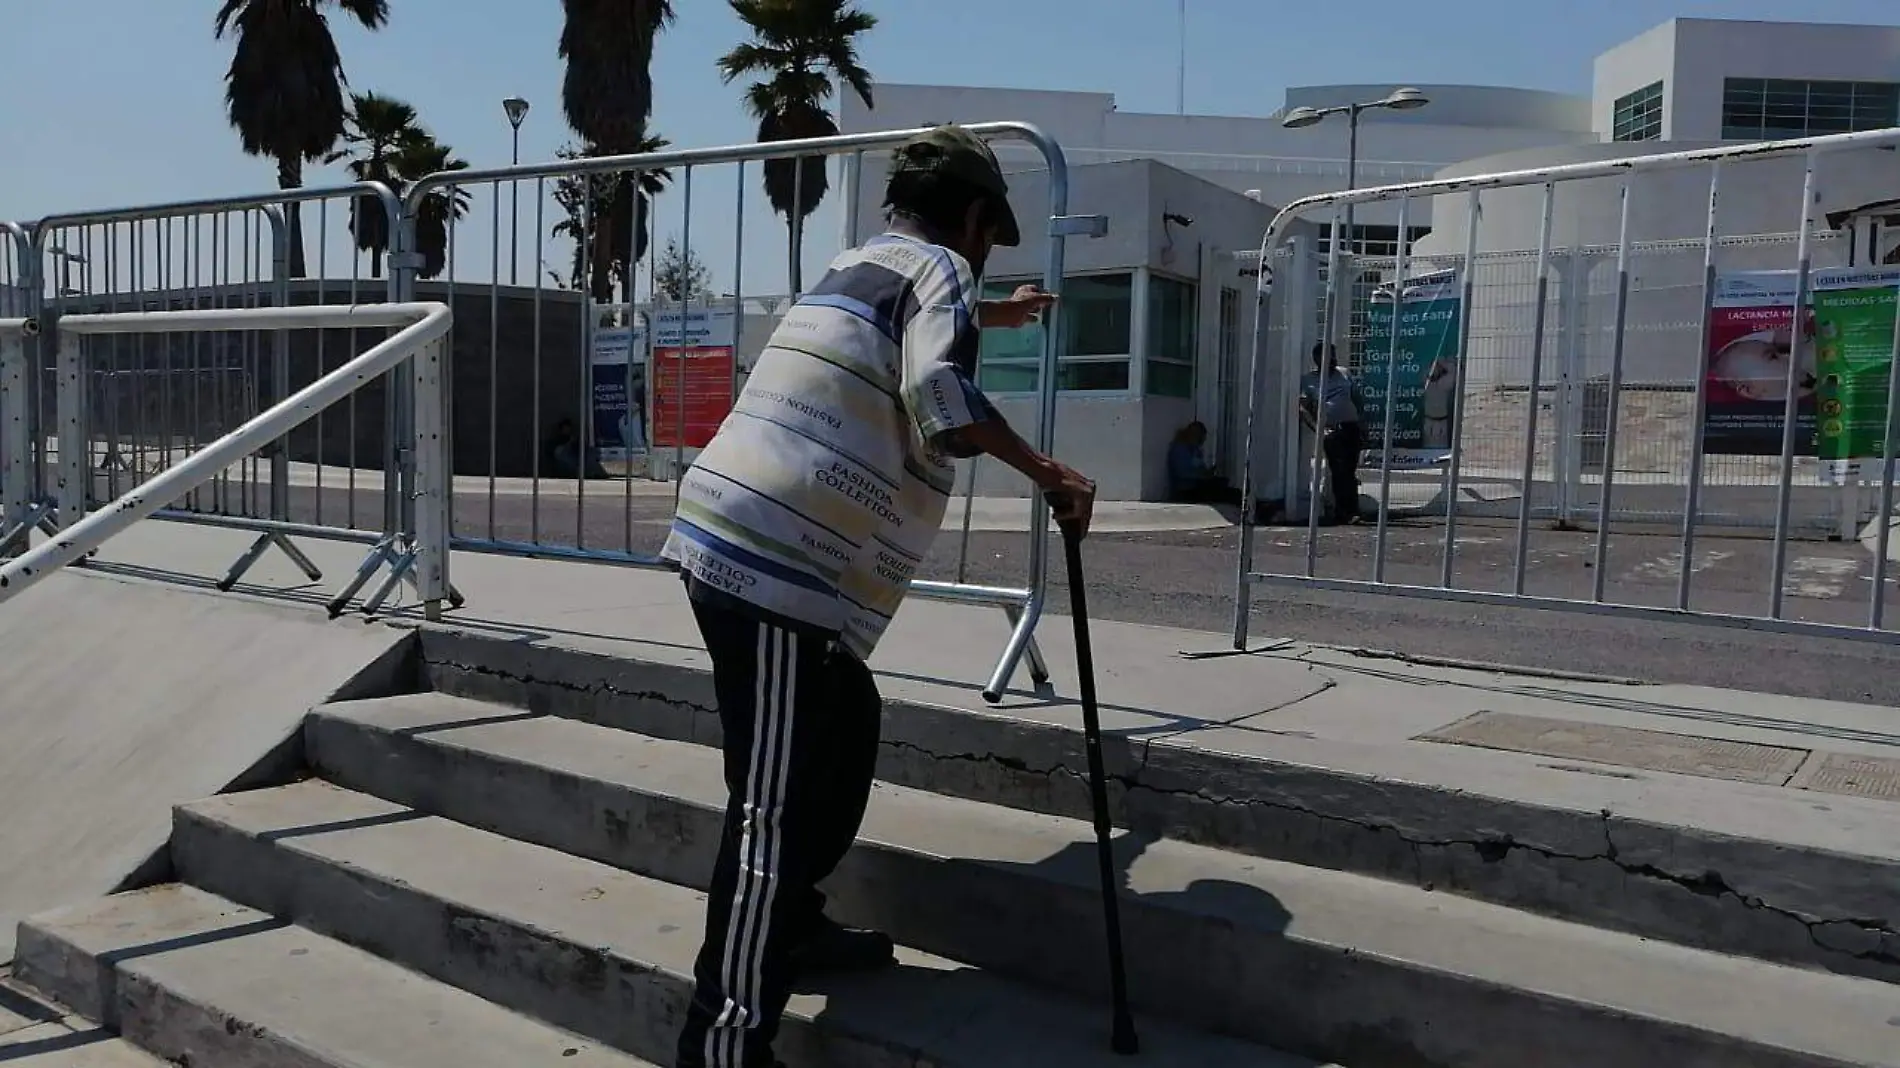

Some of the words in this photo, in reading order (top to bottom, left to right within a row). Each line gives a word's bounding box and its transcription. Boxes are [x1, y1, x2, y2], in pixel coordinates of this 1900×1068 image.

[1367, 309, 1420, 323] Manén
[1365, 325, 1426, 338] distncia
[1366, 345, 1415, 361] Tómlo
[1386, 362, 1421, 374] srio
[1363, 384, 1426, 399] Qudate
[831, 462, 893, 505] FASHION
